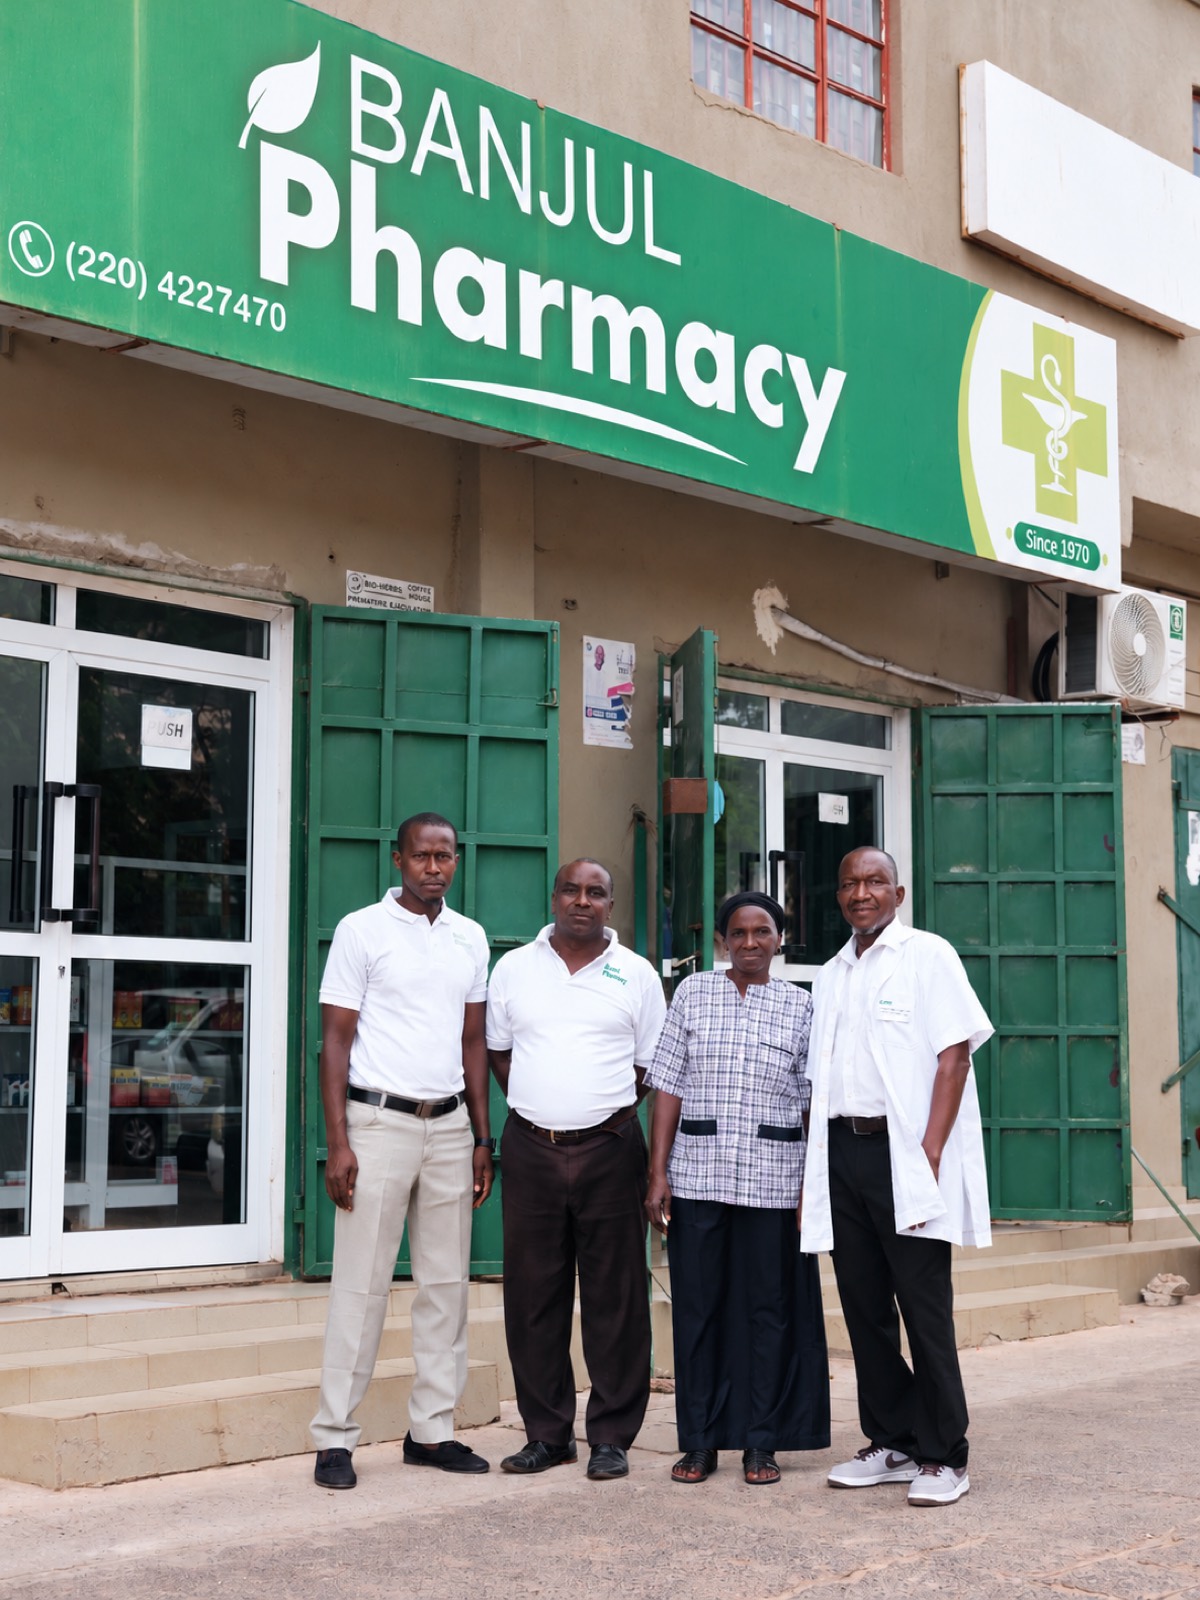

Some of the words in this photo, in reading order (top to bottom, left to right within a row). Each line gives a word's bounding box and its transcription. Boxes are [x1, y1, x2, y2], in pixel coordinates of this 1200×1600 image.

[350, 55, 682, 266] BANJUL
[65, 241, 148, 301] (220)
[157, 270, 287, 333] 4227470
[259, 140, 847, 474] Pharmacy
[1026, 528, 1058, 556] Since
[1060, 538, 1090, 564] 1970
